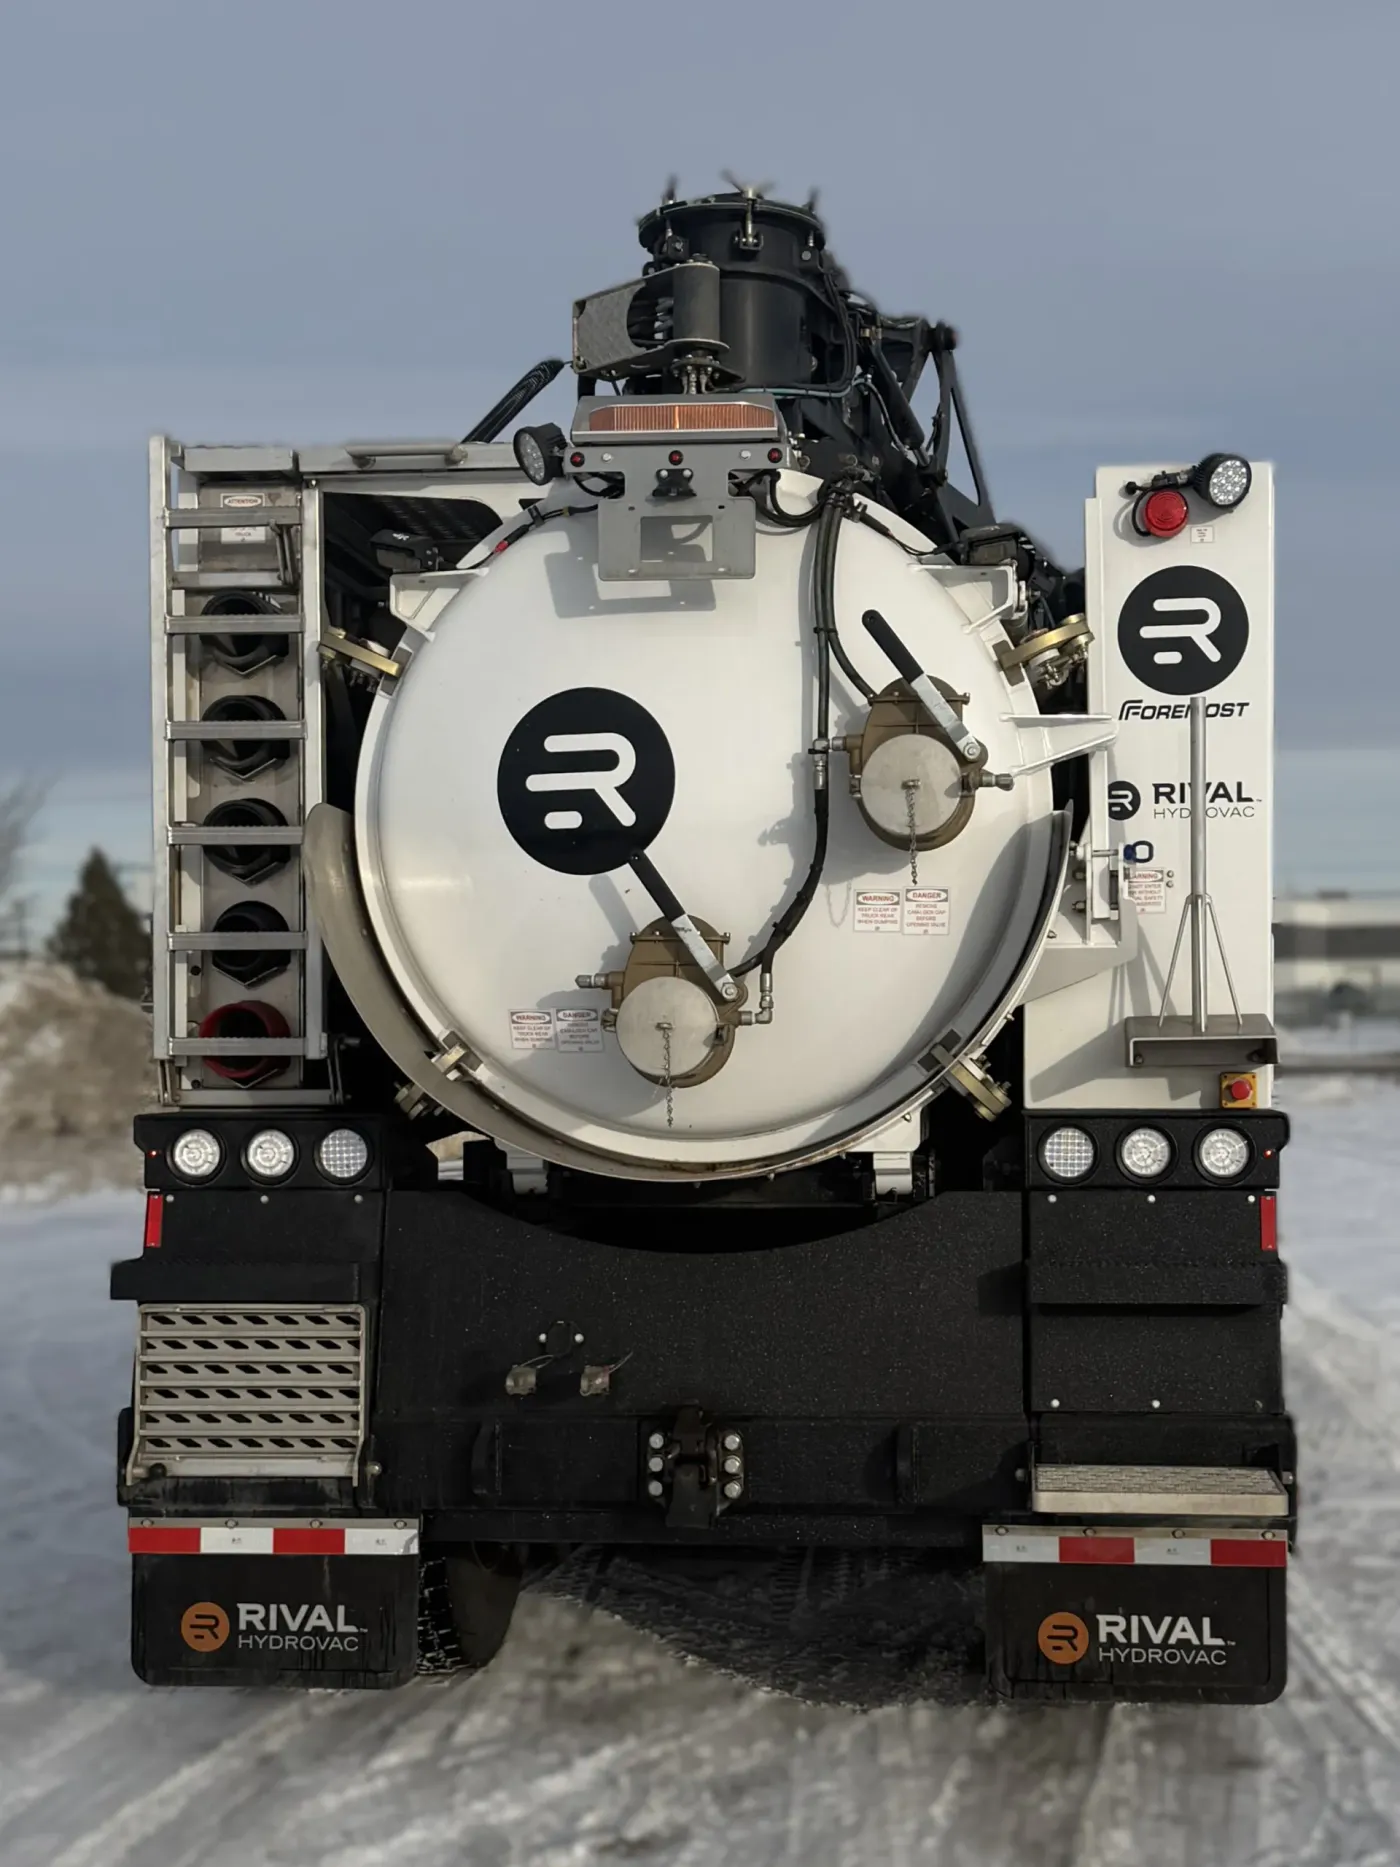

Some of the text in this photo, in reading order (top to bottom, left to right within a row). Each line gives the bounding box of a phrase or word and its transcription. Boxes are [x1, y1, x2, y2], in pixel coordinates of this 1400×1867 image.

[1153, 806, 1255, 819] HYDOVAC
[237, 1603, 359, 1633] RIVAL
[1096, 1614, 1226, 1646] RIVAL
[238, 1635, 359, 1651] HYDROVAC
[1099, 1648, 1227, 1666] HYDROVAC
